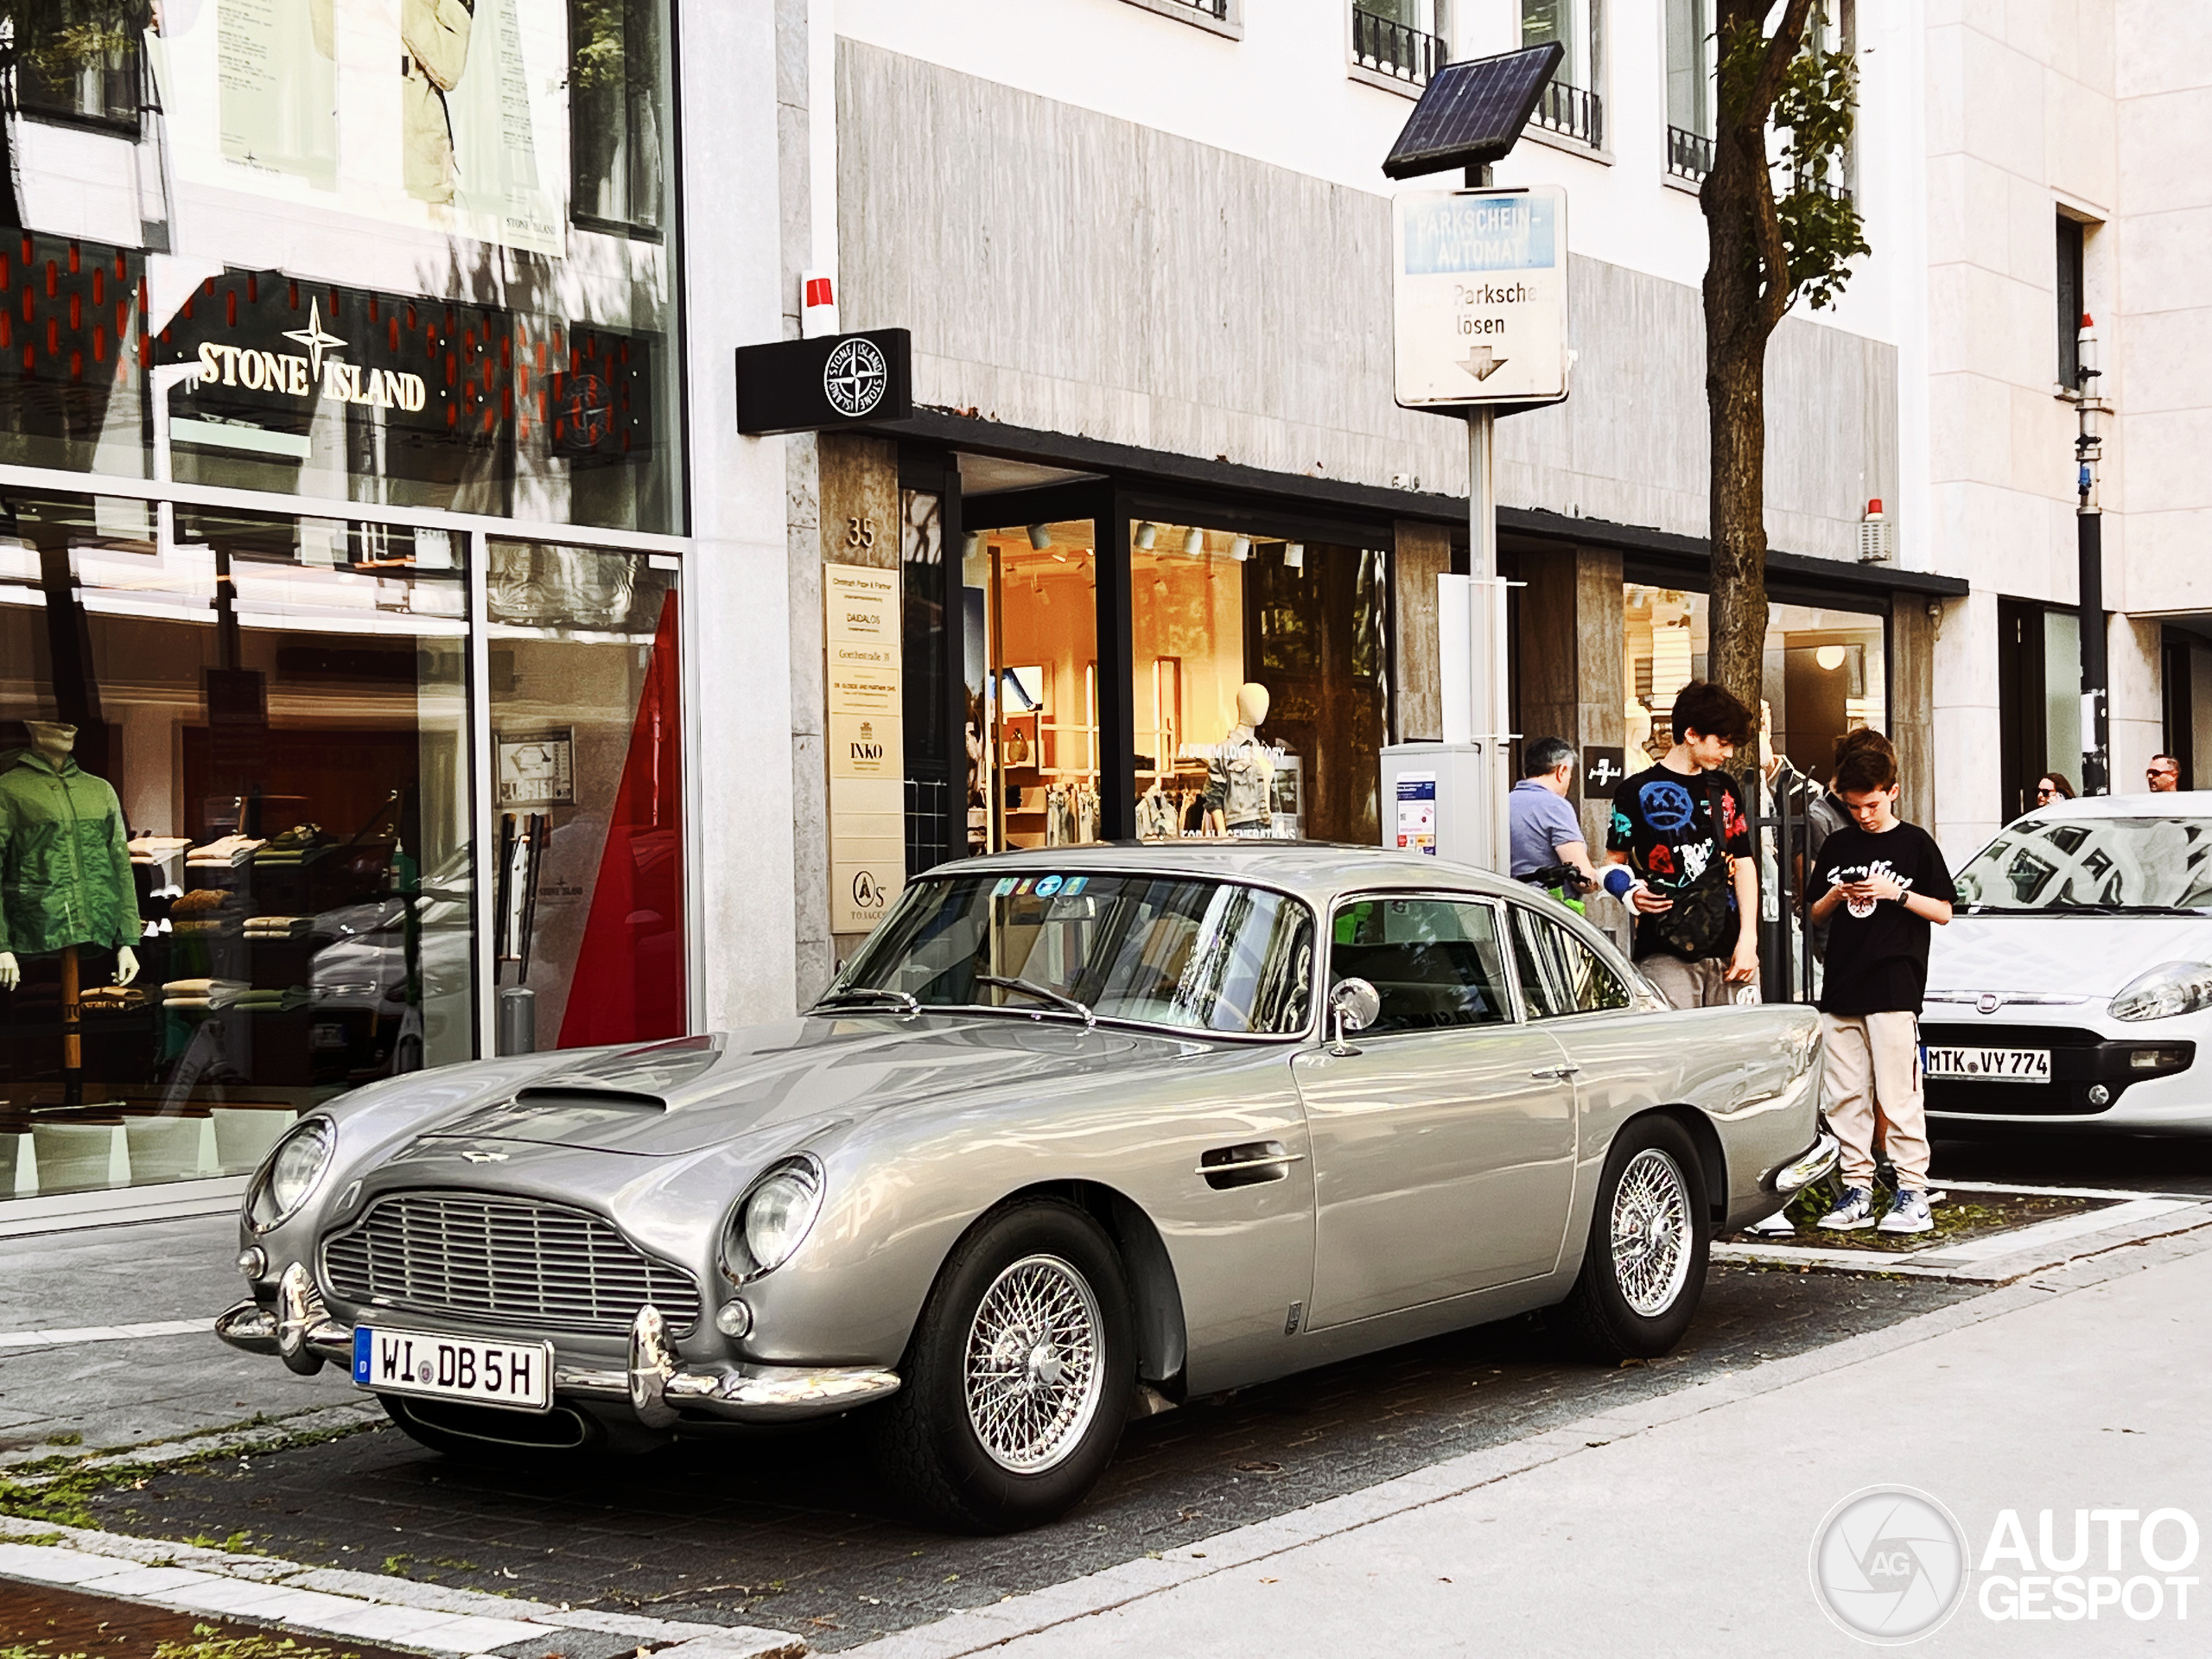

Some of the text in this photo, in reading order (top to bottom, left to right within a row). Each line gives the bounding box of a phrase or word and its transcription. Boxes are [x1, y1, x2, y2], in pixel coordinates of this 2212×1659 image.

[1437, 238, 1523, 264] AUTOMAT
[1457, 314, 1504, 334] lösen
[829, 343, 882, 376] STONE ISLAND
[198, 342, 426, 411] STONE ISLAND
[846, 517, 875, 548] 35
[850, 742, 883, 760] INKO
[1929, 1050, 2049, 1075] MTK VY 774
[382, 1338, 416, 1382] WI
